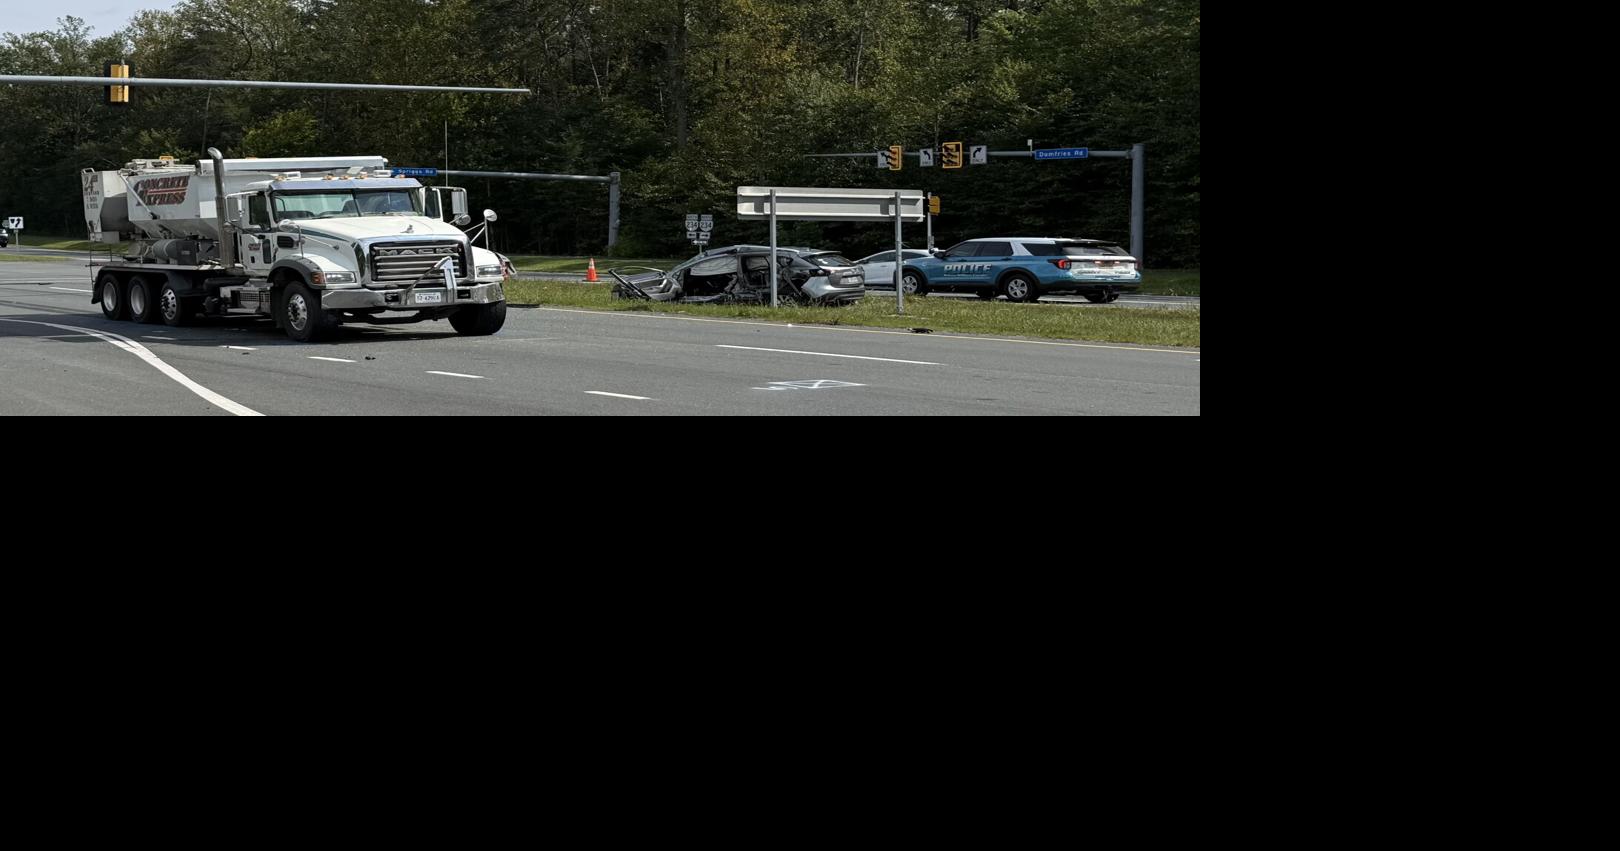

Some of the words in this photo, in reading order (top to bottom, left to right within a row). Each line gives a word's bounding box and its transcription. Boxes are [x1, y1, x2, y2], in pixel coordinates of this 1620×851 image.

[133, 175, 190, 192] CONCRETE
[135, 189, 187, 206] EXPRESS
[701, 221, 712, 229] 234
[379, 247, 455, 255] MACK
[944, 263, 992, 273] POLICE
